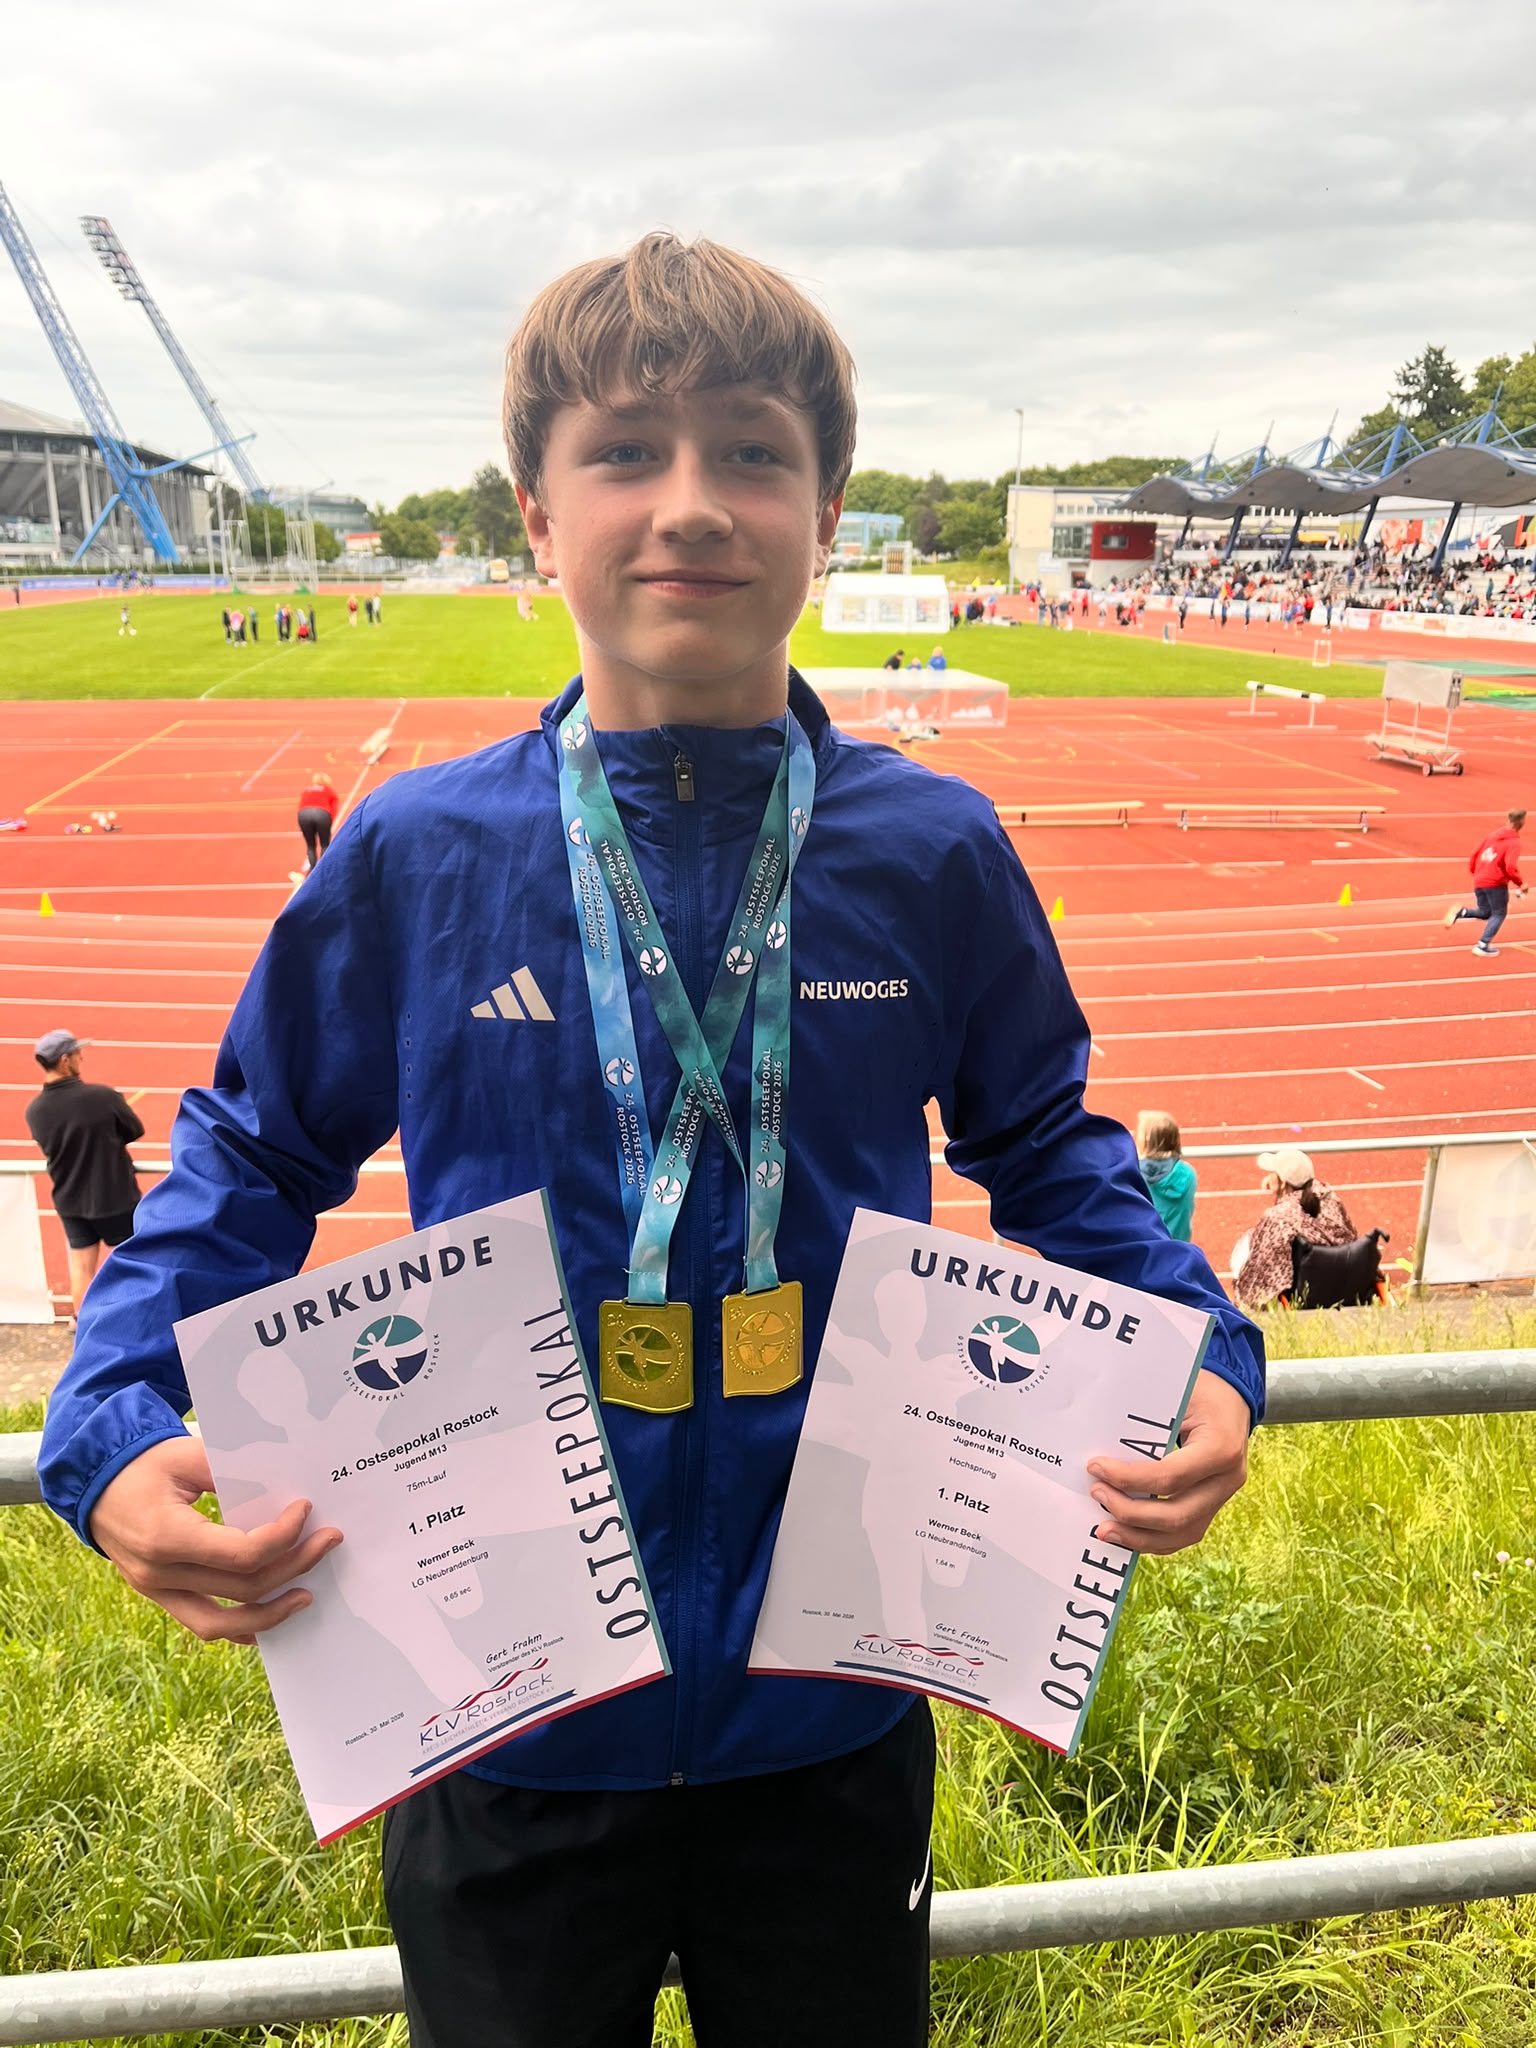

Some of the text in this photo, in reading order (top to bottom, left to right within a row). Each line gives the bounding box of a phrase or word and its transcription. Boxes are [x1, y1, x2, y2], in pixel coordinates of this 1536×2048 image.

[600, 840, 634, 921] OSTSEEPOKAL
[614, 849, 648, 926] ROSTOCK 2026
[739, 838, 776, 938] 24. OSTSEEPOKAL
[753, 853, 782, 929] ROSTOCK 2026
[591, 875, 610, 959] OSTSEEPOKAL
[799, 978, 909, 1000] NEUWOGES
[672, 1088, 695, 1146] OSTSEEPO
[761, 1048, 773, 1131] OSTSEEPOKAL
[772, 1061, 783, 1140] ROSTOCK 2026
[616, 1107, 635, 1185] ROSTOCK 2026
[629, 1114, 647, 1197] OSTSEEPOKAL
[681, 1108, 701, 1159] ROSTOCK
[254, 1236, 493, 1347] URKUNDE
[910, 1248, 1141, 1344] URKUNDE
[343, 1333, 440, 1402] OSTSEEPOKAL ROSTOCK
[958, 1335, 1052, 1394] OSTSEEPOKAL ROSTOCK
[331, 1405, 499, 1482] 24. Ostseepokal Rostock
[394, 1444, 448, 1473] Jugend M13
[903, 1404, 1063, 1467] 24. Ostseepokal Rostock
[953, 1435, 1005, 1458] Jugend M13
[406, 1470, 447, 1493] 75m-Lauf
[524, 1298, 650, 1639] OSTSEEPOKAL
[949, 1456, 997, 1480] Hochsprung
[408, 1505, 466, 1535] 1. Platz
[928, 1518, 982, 1541] Werner Beck
[938, 1487, 990, 1514] 1. Platz
[411, 1551, 489, 1589] LG Neubrandenburg
[417, 1539, 475, 1569] Werner Beck
[915, 1529, 987, 1558] LG Neubrandenburg
[1041, 1414, 1176, 1711] OSTSEEAL
[460, 1587, 472, 1597] sec
[486, 1633, 542, 1664] Gert Frahm
[488, 1636, 565, 1673] Vorsitzender des KLV Rostock
[853, 1639, 895, 1654] KLV
[897, 1647, 981, 1681] Rostock
[935, 1622, 990, 1647] Gert Frahm
[420, 1673, 553, 1746] KLV Rostock
